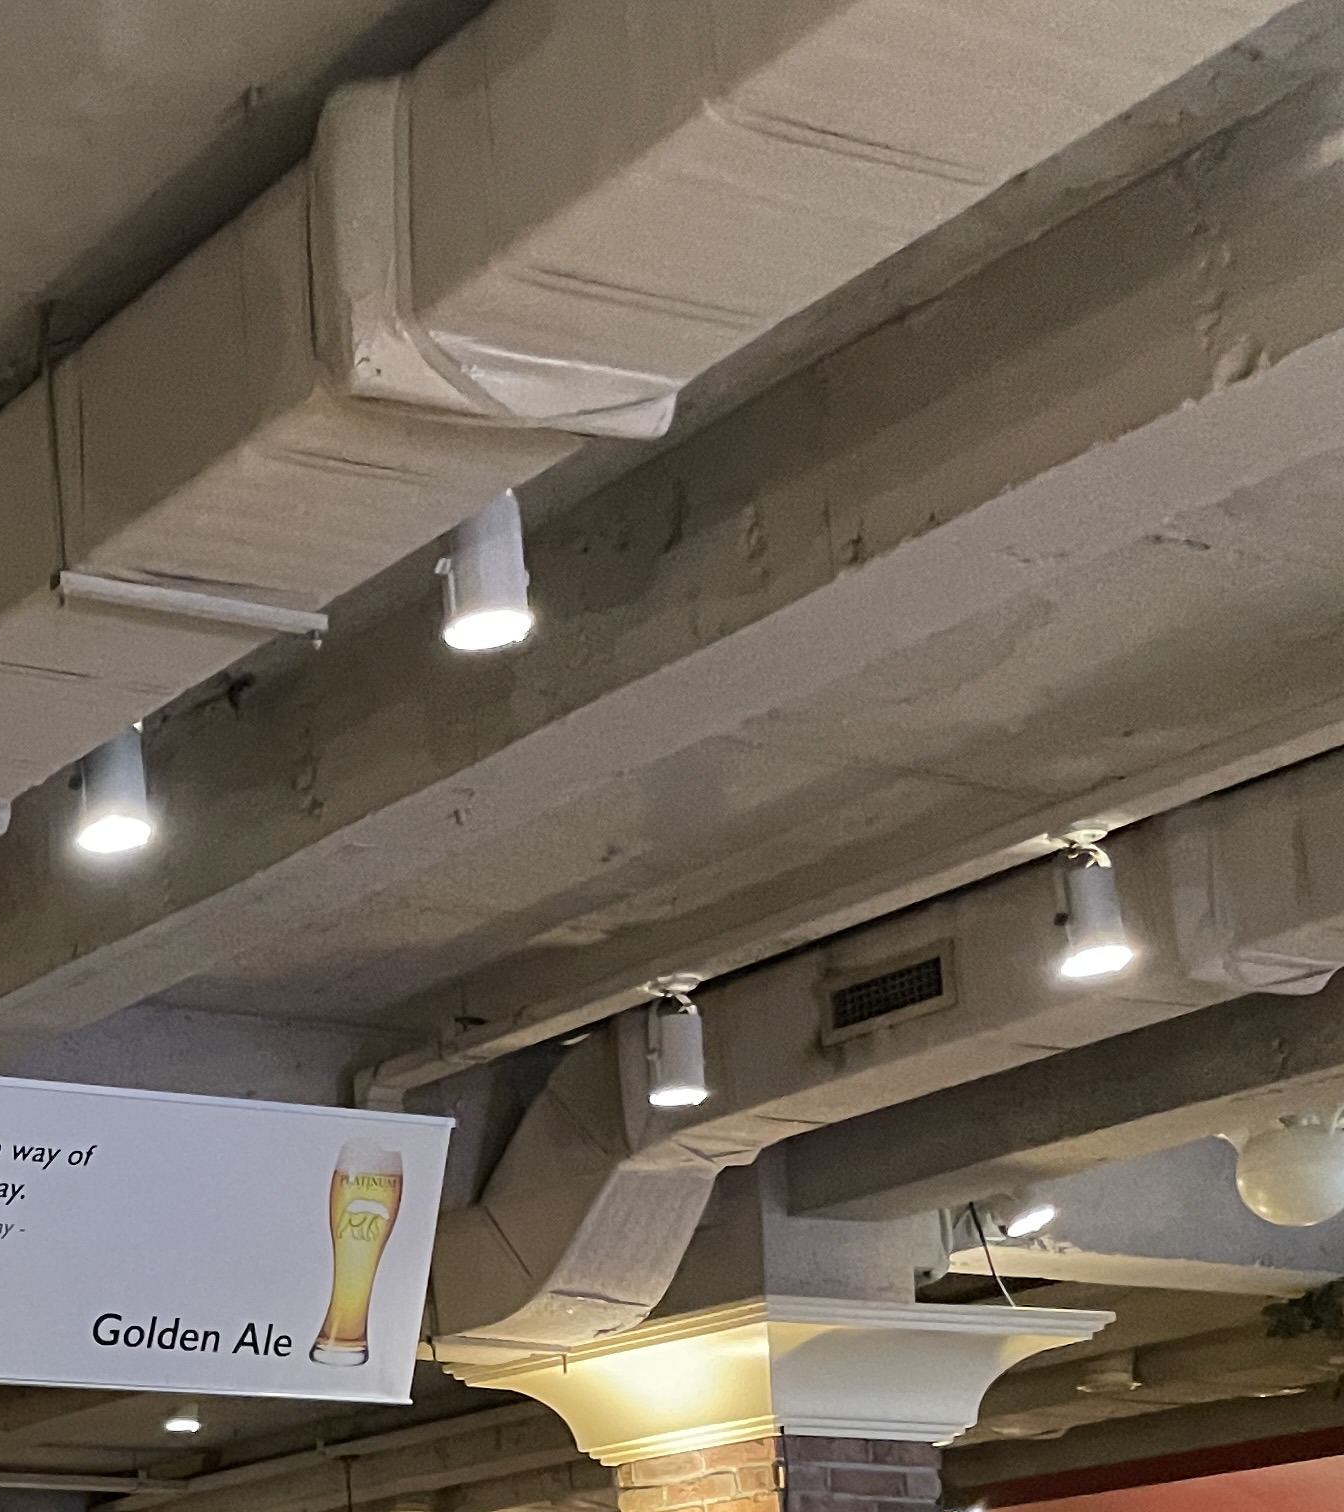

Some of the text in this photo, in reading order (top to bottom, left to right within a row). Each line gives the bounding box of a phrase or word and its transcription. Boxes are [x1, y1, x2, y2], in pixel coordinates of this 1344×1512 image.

[12, 1144, 61, 1170] way
[67, 1144, 98, 1166] of
[92, 1312, 292, 1357] Golden Ale
